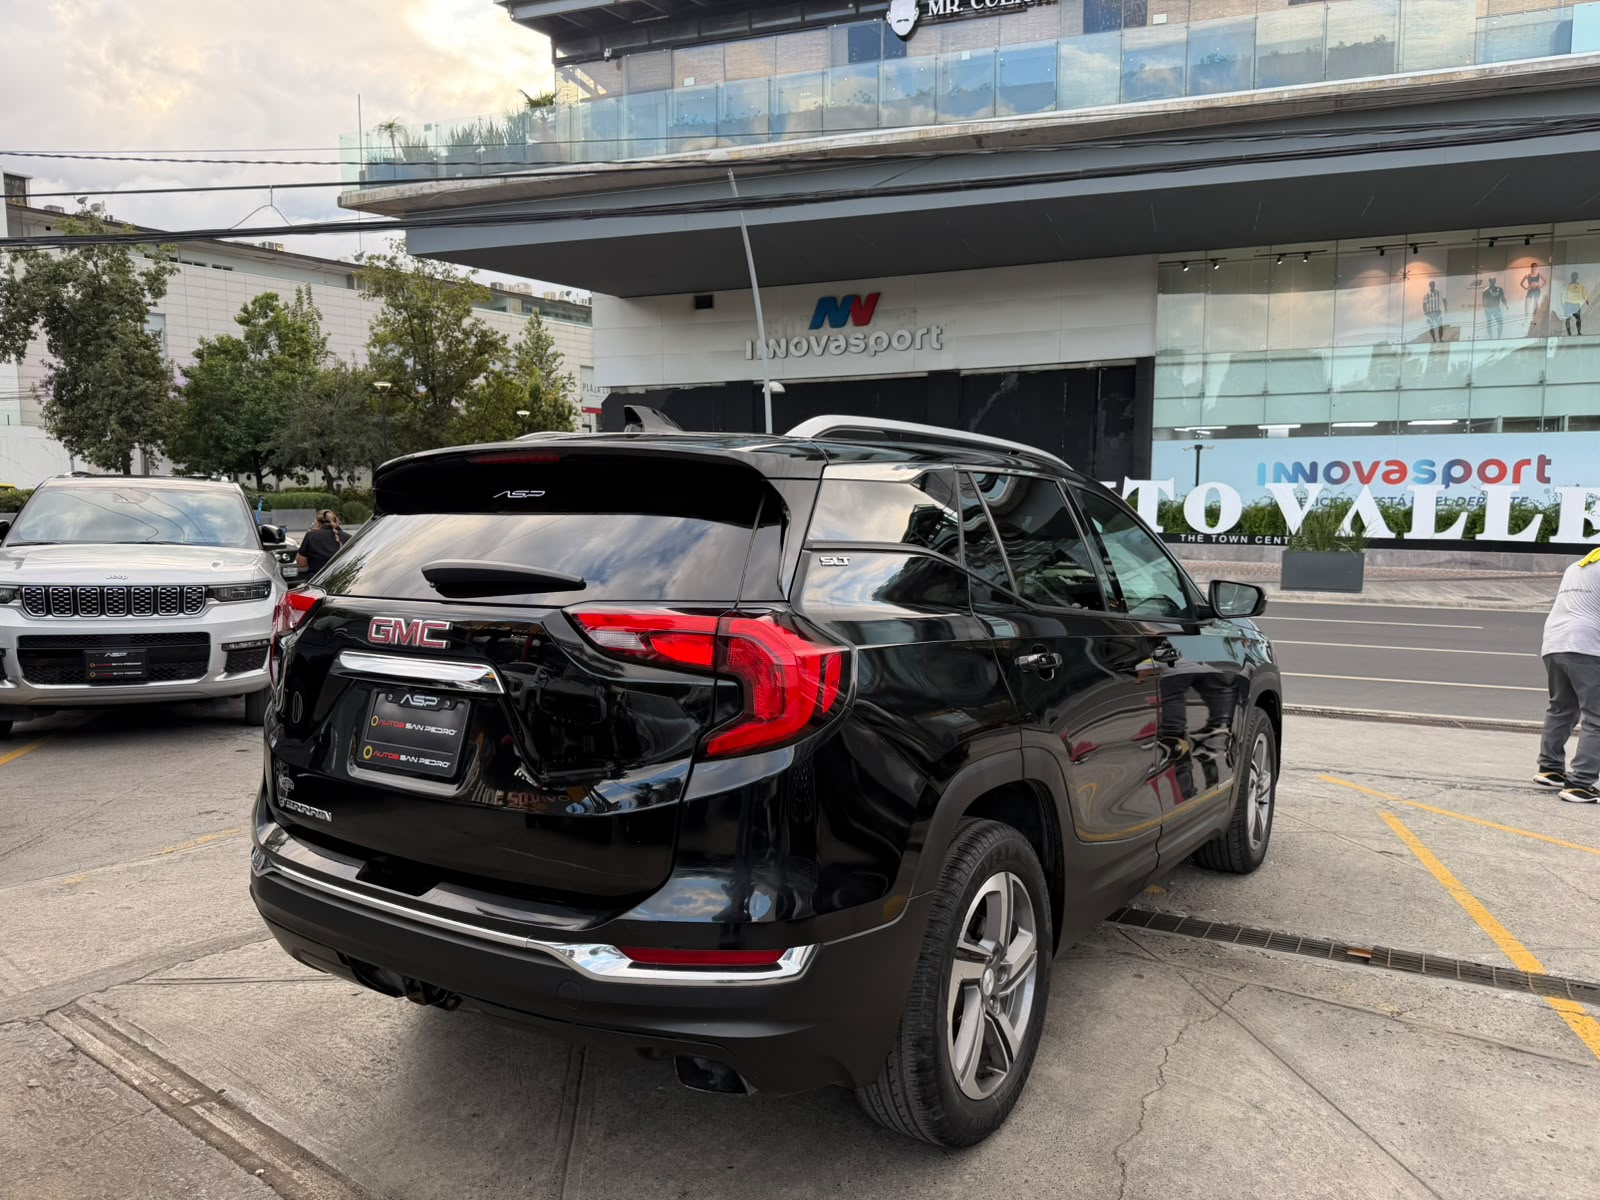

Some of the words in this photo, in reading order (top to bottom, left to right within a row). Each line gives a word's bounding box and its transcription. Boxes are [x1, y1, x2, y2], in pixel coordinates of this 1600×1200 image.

[493, 490, 545, 498] ASP
[1180, 533, 1205, 543] THE
[1211, 534, 1248, 544] TOWN
[819, 556, 850, 567] SLT
[368, 616, 452, 650] GMC
[400, 694, 438, 707] ASP
